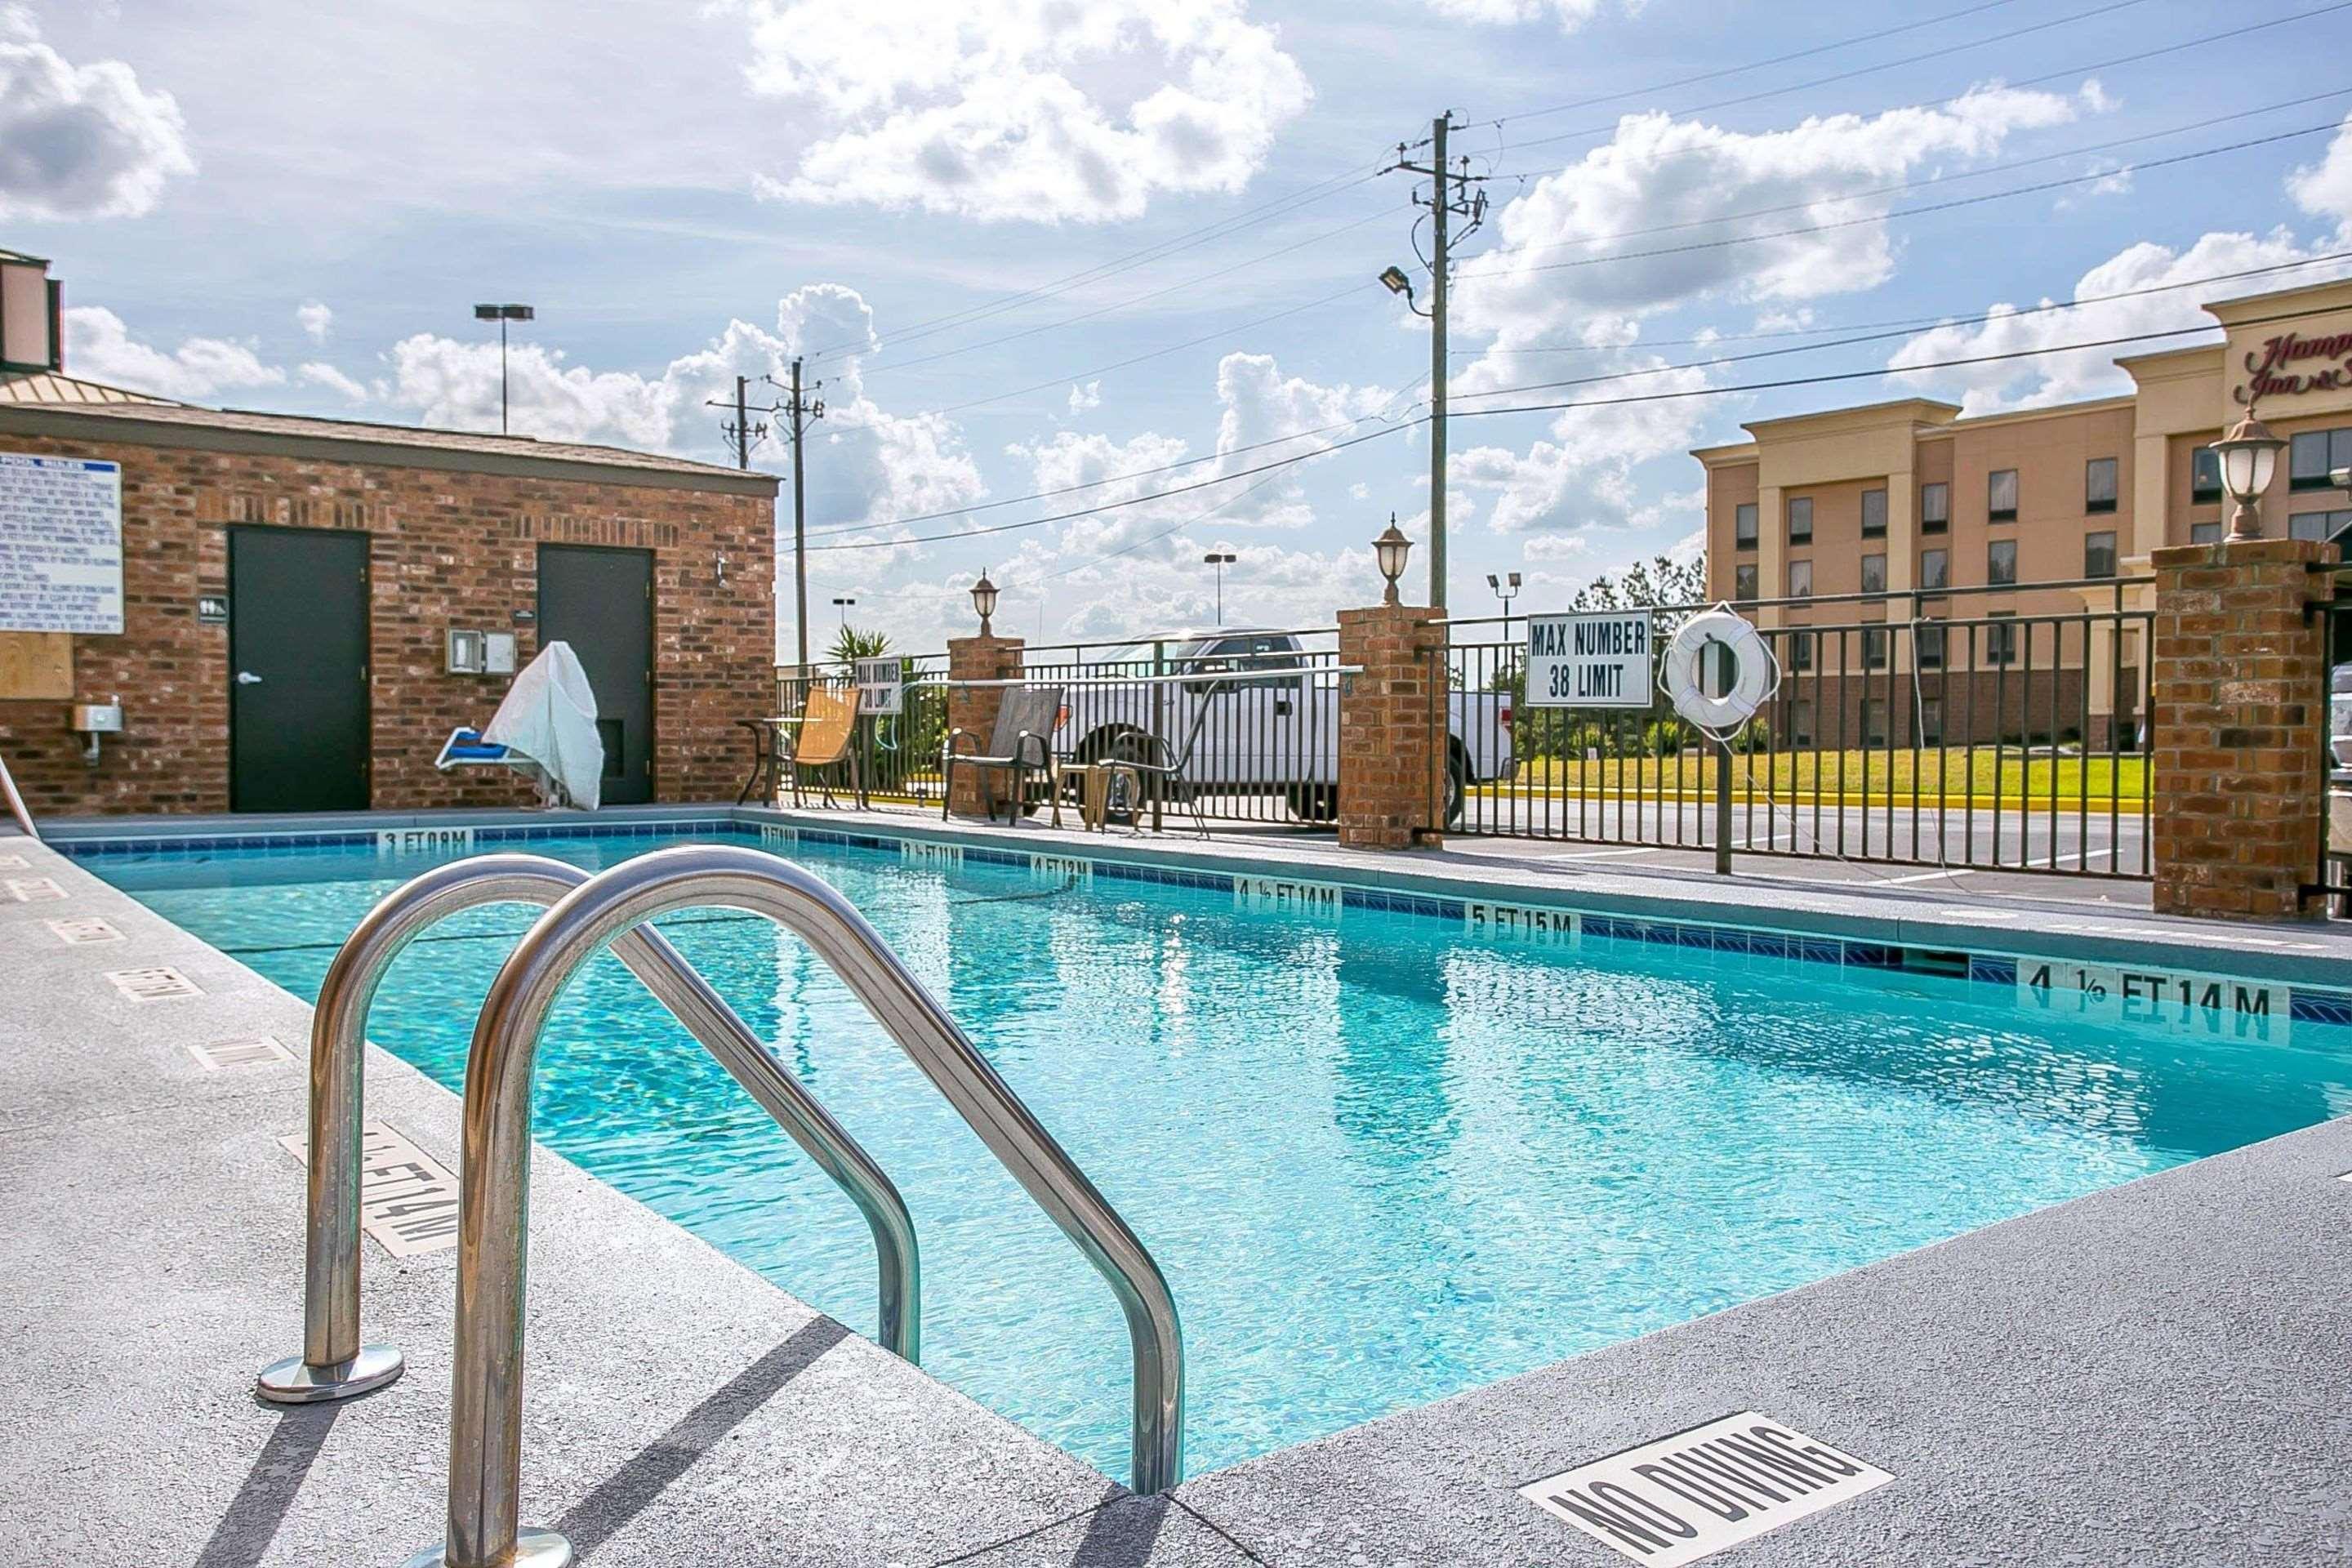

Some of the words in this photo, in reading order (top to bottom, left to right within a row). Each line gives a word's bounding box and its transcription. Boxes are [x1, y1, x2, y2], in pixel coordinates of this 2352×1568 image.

[2233, 370, 2315, 407] Inn
[1531, 623, 1566, 657] MAX
[1575, 621, 1646, 656] NUMBER
[858, 663, 871, 684] MAX
[873, 662, 899, 683] NUMBER
[1549, 664, 1570, 697] 38
[1577, 664, 1624, 697] LIMIT
[865, 688, 872, 708] 38
[875, 688, 892, 708] LIMIT
[2029, 964, 2051, 990] 4
[1547, 1481, 1699, 1555] NO
[1630, 1425, 1865, 1523] DIVING
